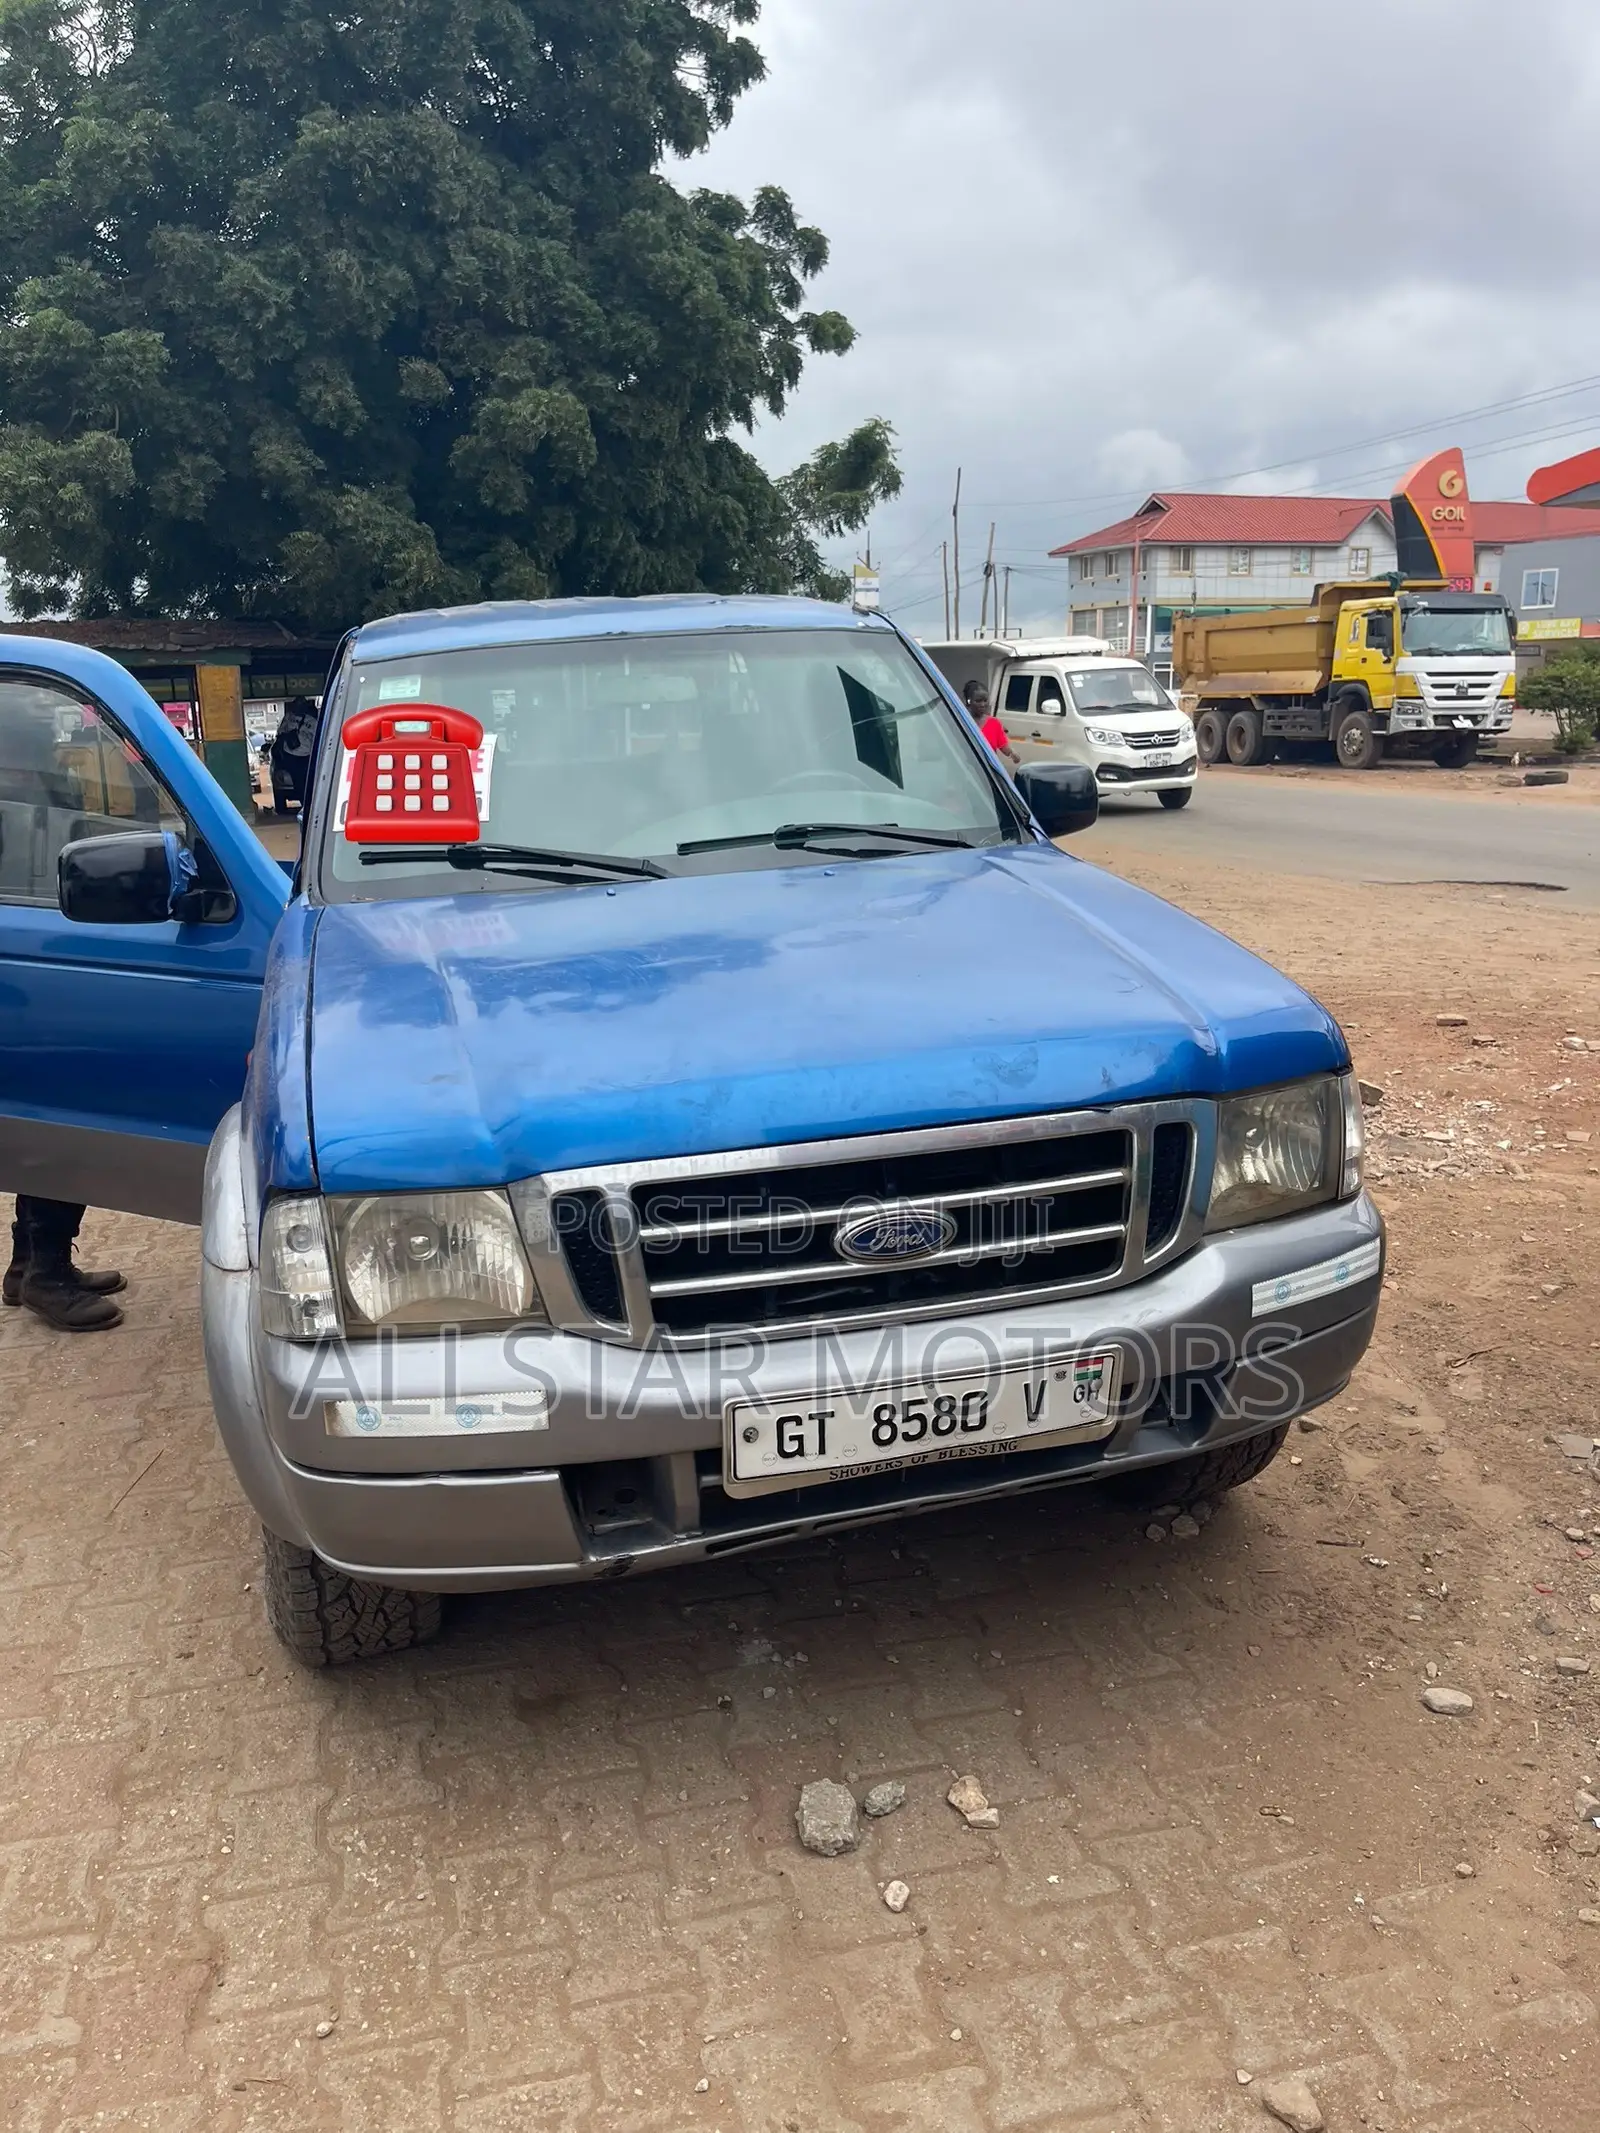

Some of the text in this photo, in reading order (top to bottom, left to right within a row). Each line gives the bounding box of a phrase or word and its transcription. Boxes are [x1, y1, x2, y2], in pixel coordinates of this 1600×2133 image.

[1431, 506, 1466, 521] GOIL
[870, 1225, 924, 1250] Ford
[775, 1379, 1048, 1459] GT 8580 V
[829, 1460, 904, 1480] SHOWERS
[938, 1440, 1018, 1460] BLESSING
